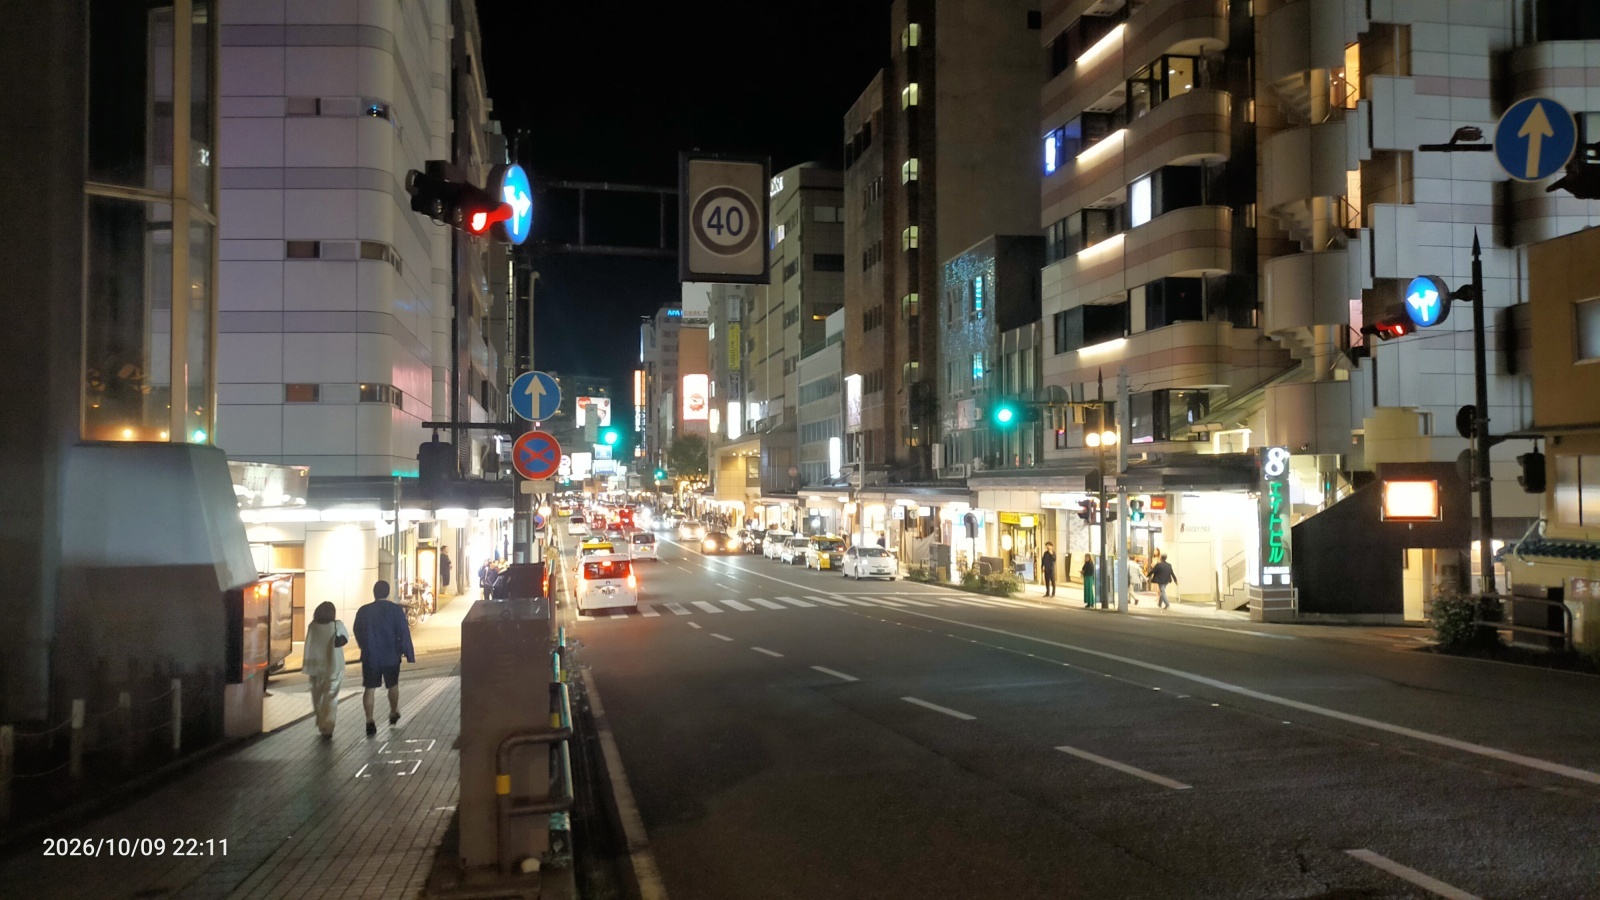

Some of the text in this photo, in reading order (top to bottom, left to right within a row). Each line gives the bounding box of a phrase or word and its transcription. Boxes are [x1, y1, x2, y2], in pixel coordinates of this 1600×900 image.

[707, 206, 744, 236] 40
[1265, 447, 1285, 476] 8
[1268, 481, 1285, 563] エイトビル
